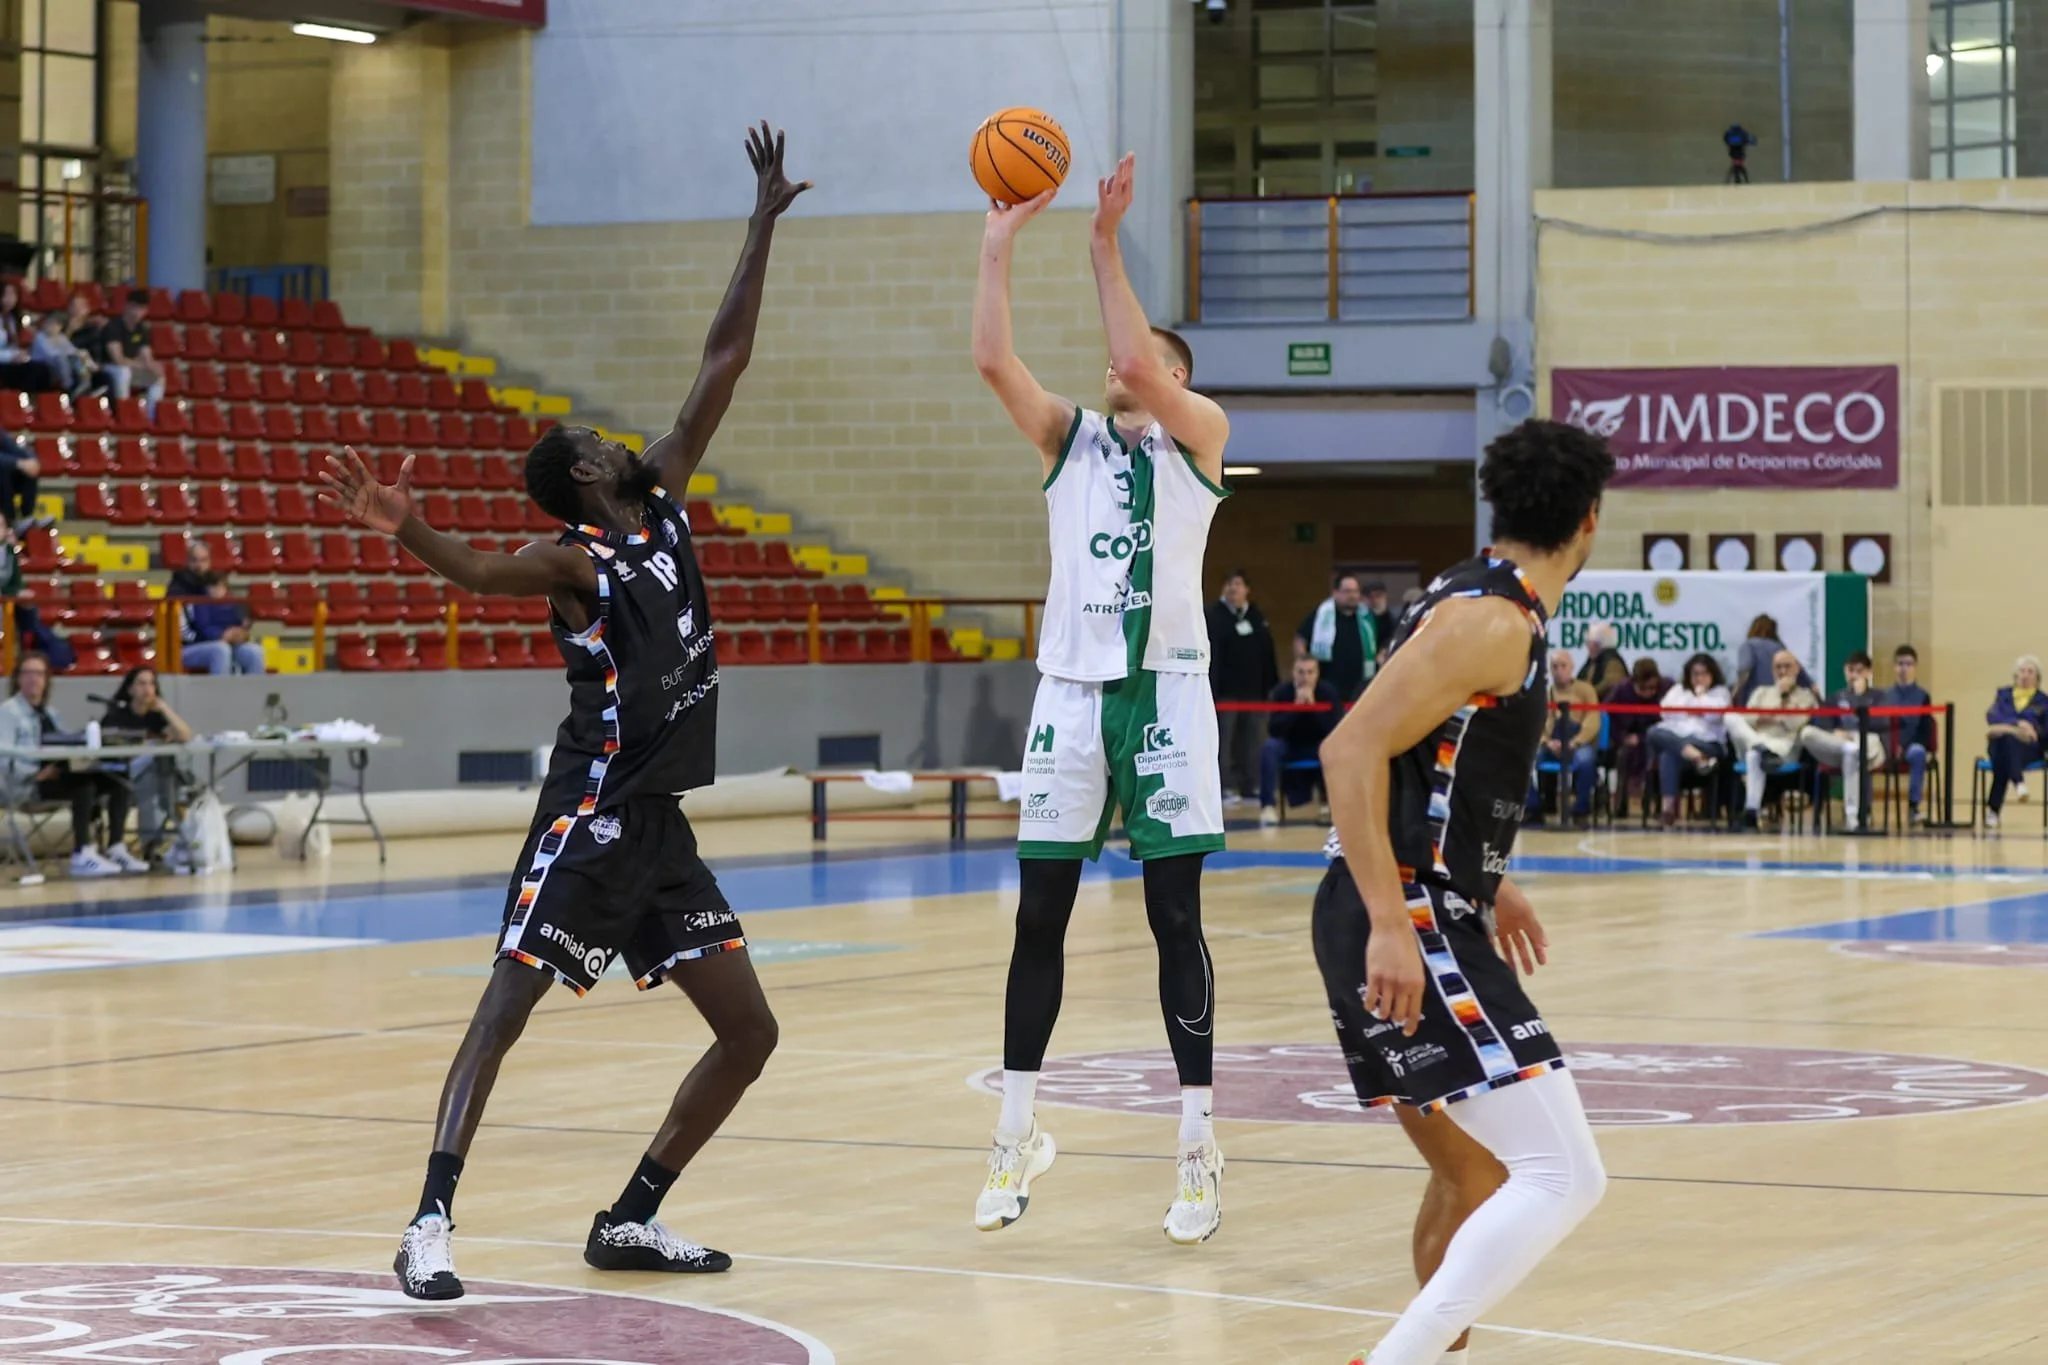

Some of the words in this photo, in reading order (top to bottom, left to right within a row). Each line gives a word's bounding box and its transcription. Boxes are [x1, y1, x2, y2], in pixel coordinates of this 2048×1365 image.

[1638, 391, 1885, 444] IMDECO
[1632, 453, 1710, 472] Municipal
[1712, 453, 1735, 469] de
[1737, 453, 1810, 472] Deportes
[641, 550, 679, 592] 18
[1552, 591, 1653, 619] RDOBA.
[1137, 750, 1187, 765] Diputación
